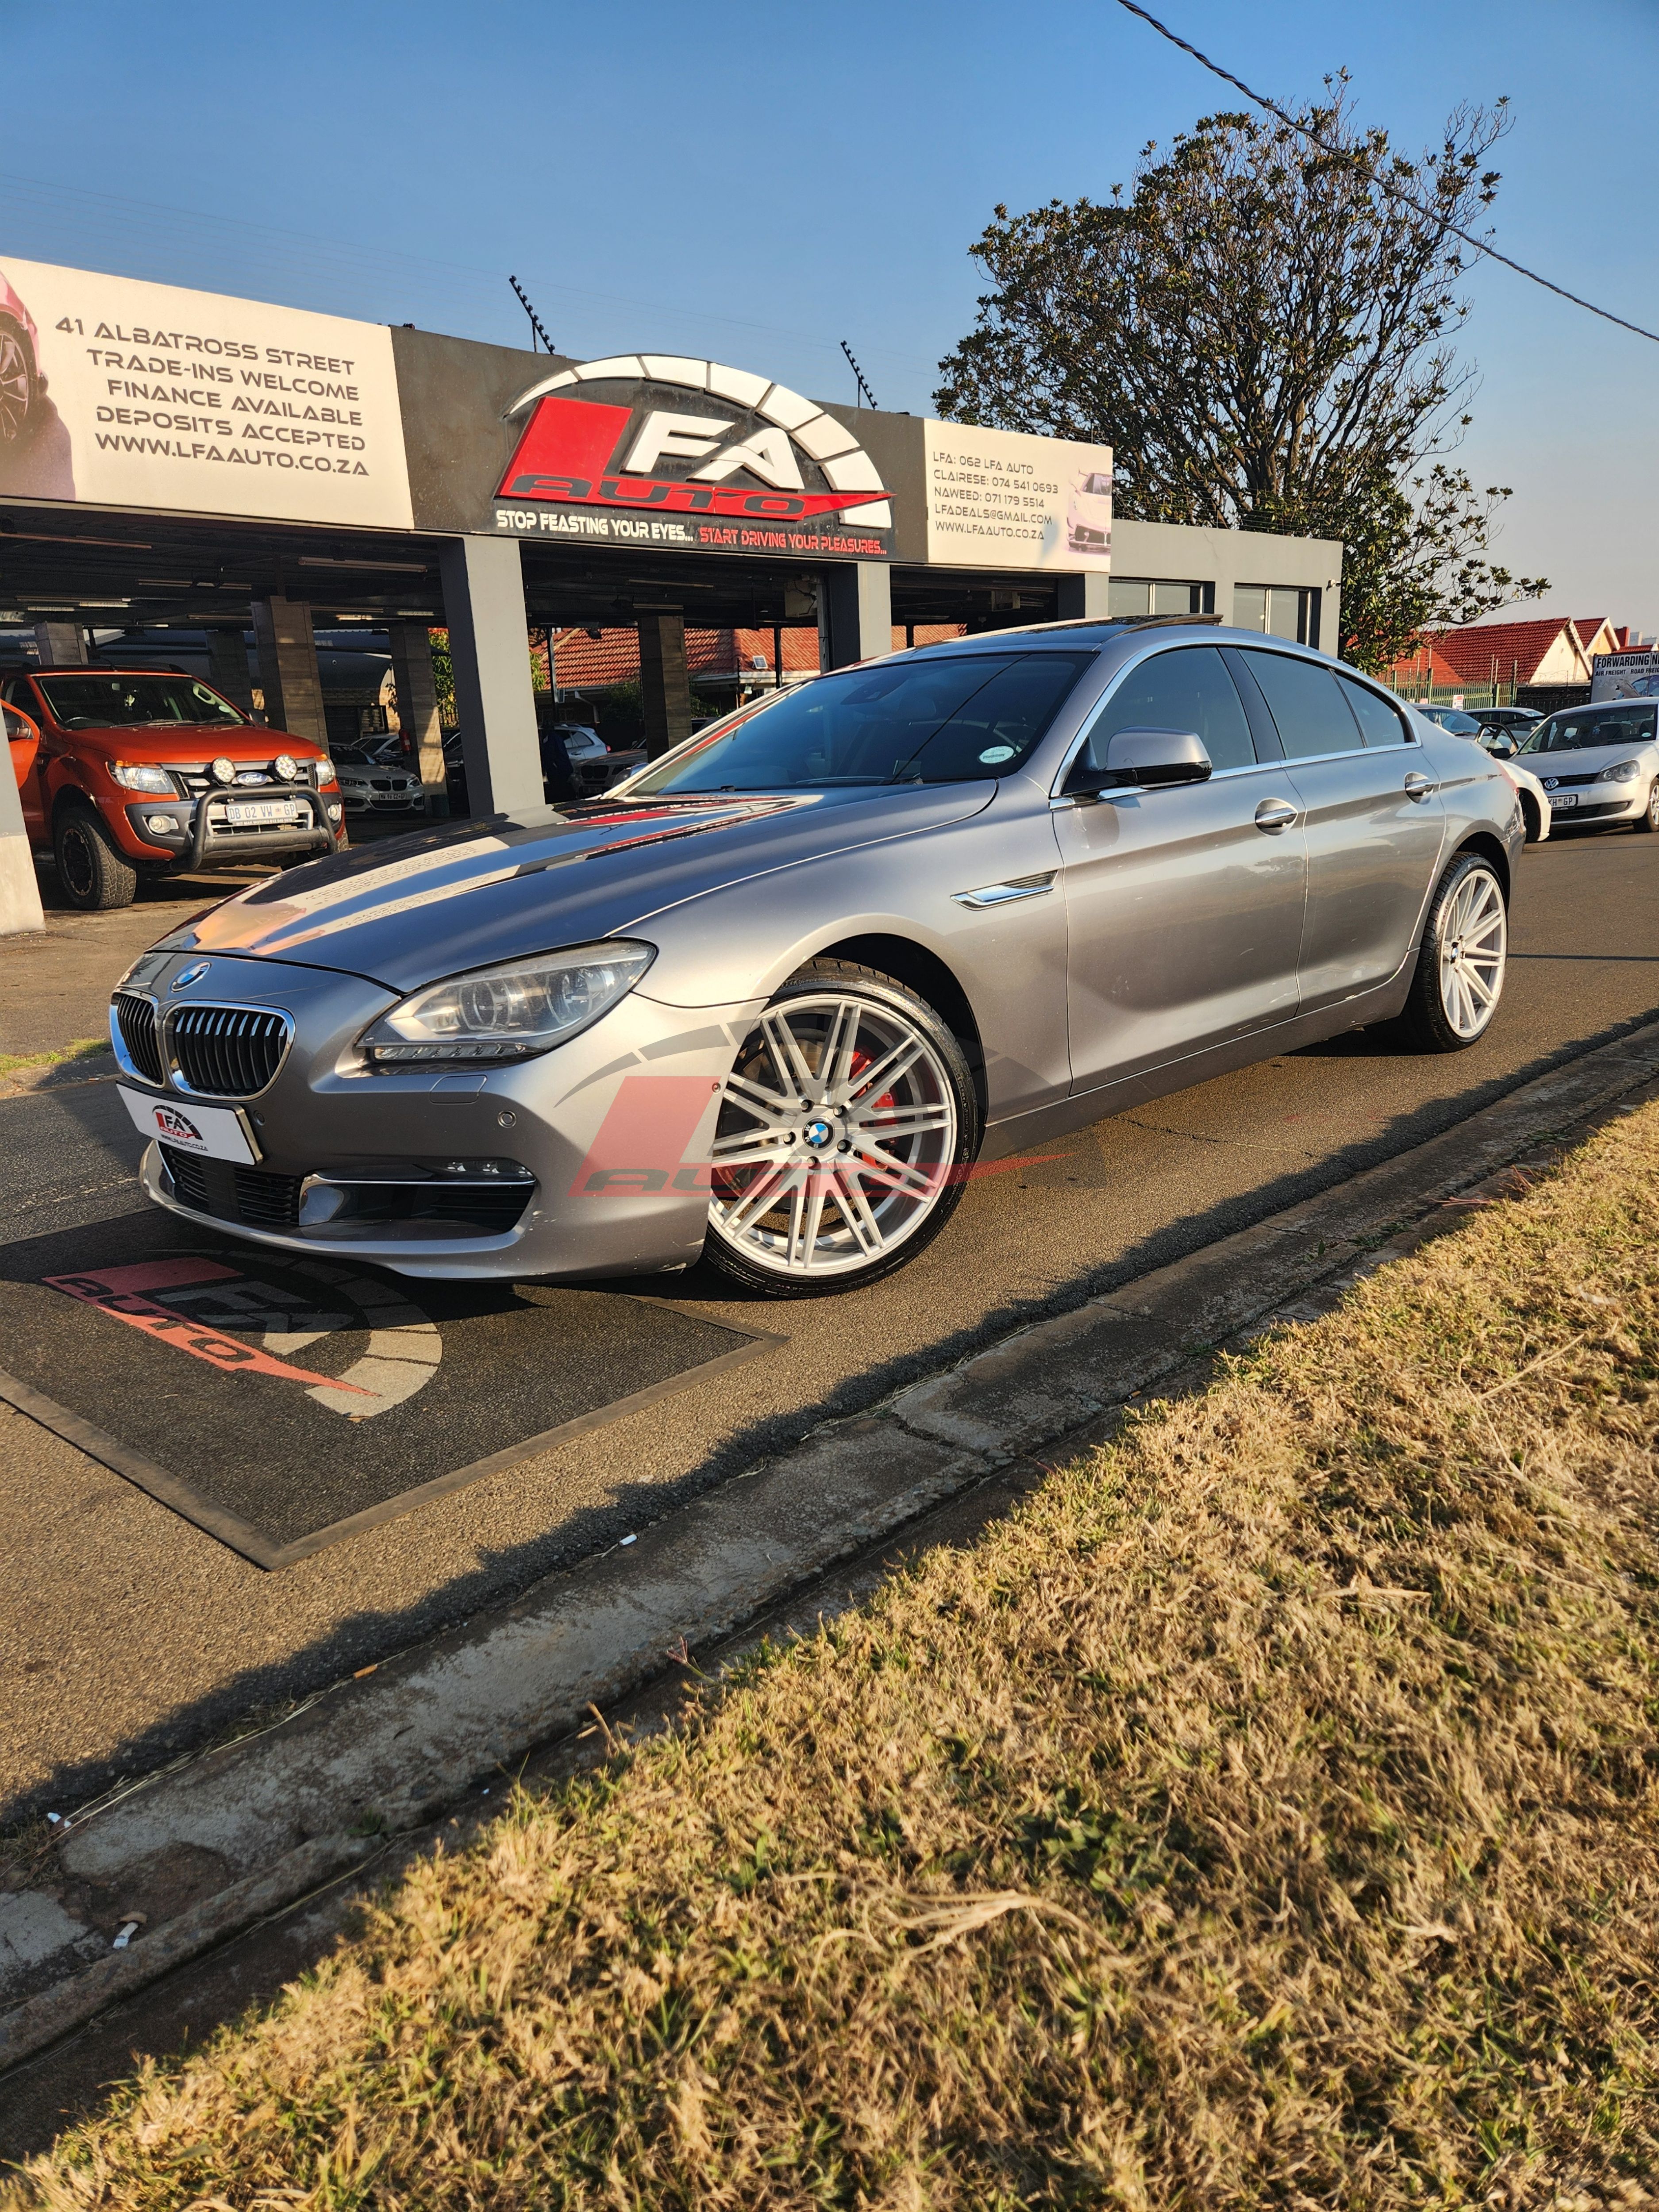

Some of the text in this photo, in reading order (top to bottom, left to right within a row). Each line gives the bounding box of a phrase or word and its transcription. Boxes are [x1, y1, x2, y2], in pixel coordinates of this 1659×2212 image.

[55, 316, 355, 375] 41 ALBATROSS STREET
[86, 348, 361, 401] TRADE-INS WELCOME
[108, 378, 363, 427] FINANCE AVAILABLE
[96, 406, 366, 451] DEPOSITS ACCEPTED
[95, 433, 370, 477] WWW.LFAAUTO.CO.ZA
[933, 451, 1034, 475] LFA: 062 LFA AUTO
[933, 469, 1059, 494] CLAIRESE: 074 541 0693
[510, 474, 804, 515] AUTO
[935, 486, 1045, 508] NAWEED: 071 179 5514
[935, 504, 1052, 525] LFADEALS@GMAIL.COM
[496, 509, 887, 555] STOP FEASTING YOUR EYES... START DRIVING YOUR PLEASURES...
[935, 520, 1045, 540] WWW.LFAAUTO.CO.ZA
[1597, 654, 1650, 669] FORWARDING
[244, 774, 262, 783] Ford
[229, 804, 295, 819] DB 02 VW GP
[160, 1126, 188, 1139] AUTO
[55, 1277, 256, 1363] AUTO
